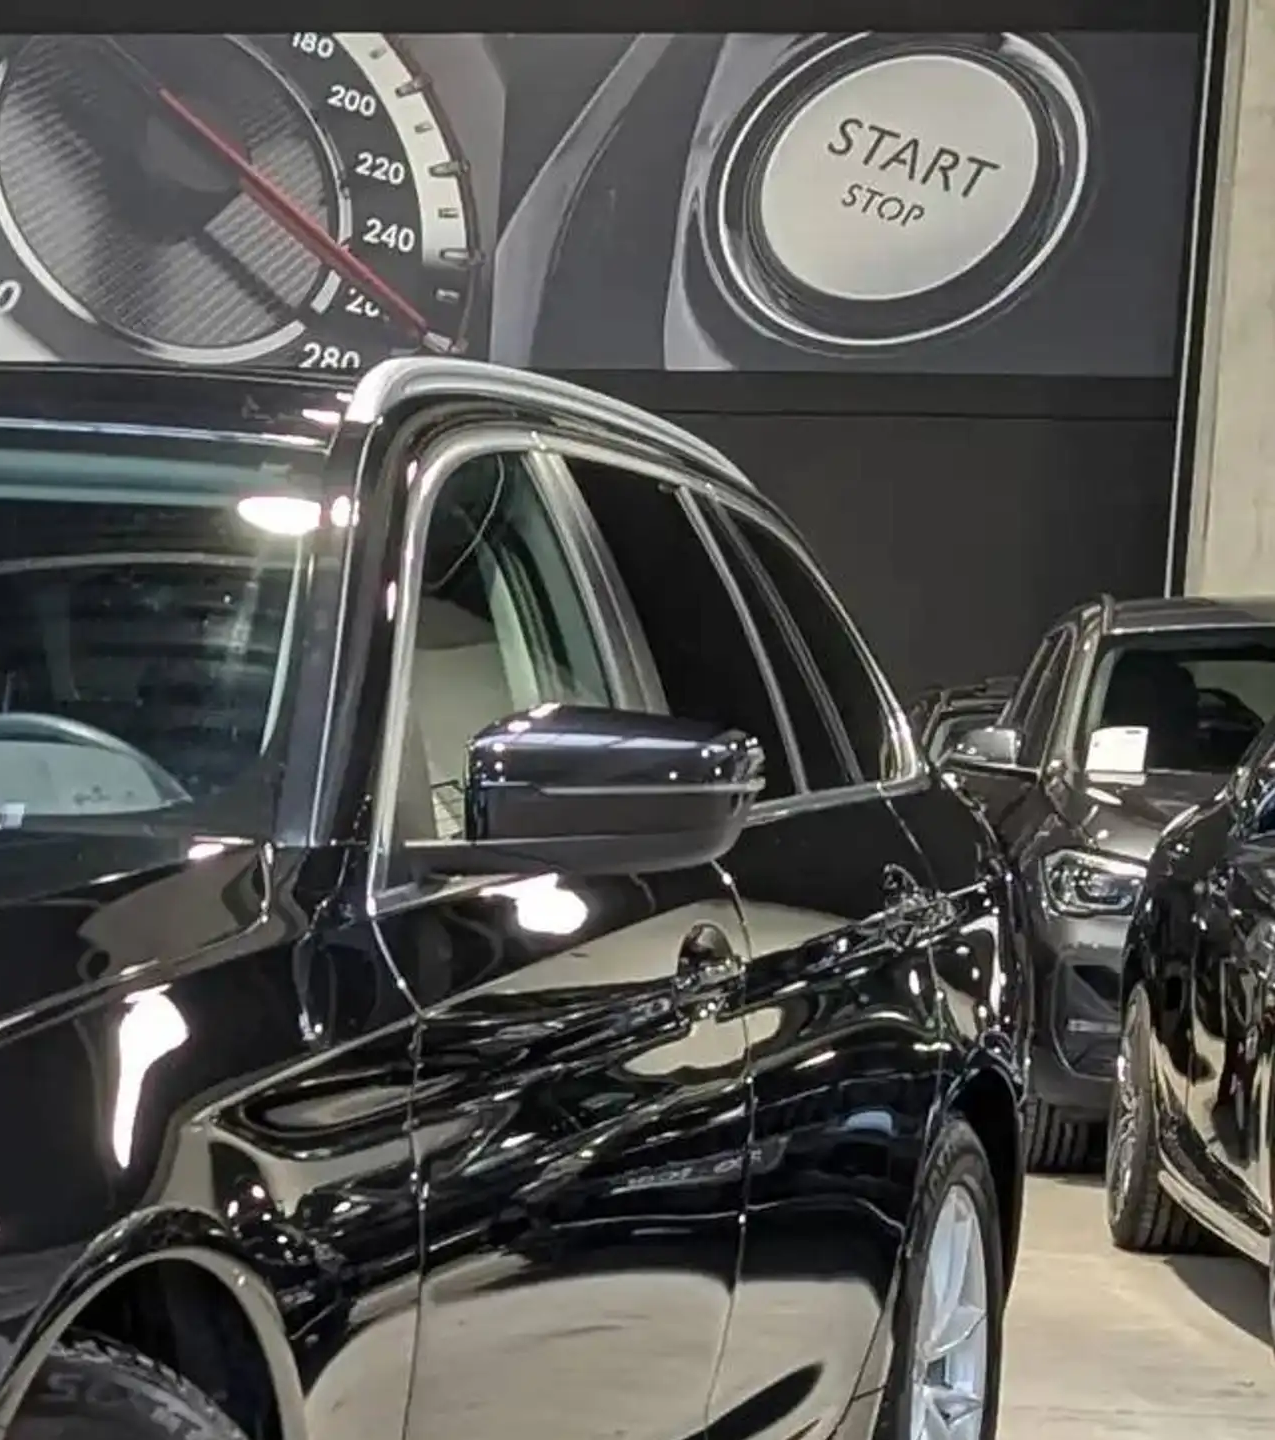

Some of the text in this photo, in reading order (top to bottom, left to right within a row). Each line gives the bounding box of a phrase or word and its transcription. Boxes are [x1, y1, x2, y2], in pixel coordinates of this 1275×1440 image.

[327, 84, 377, 117] 200
[354, 151, 406, 186] 220
[827, 117, 1001, 199] START
[841, 183, 926, 227] STOP
[362, 217, 416, 253] 240
